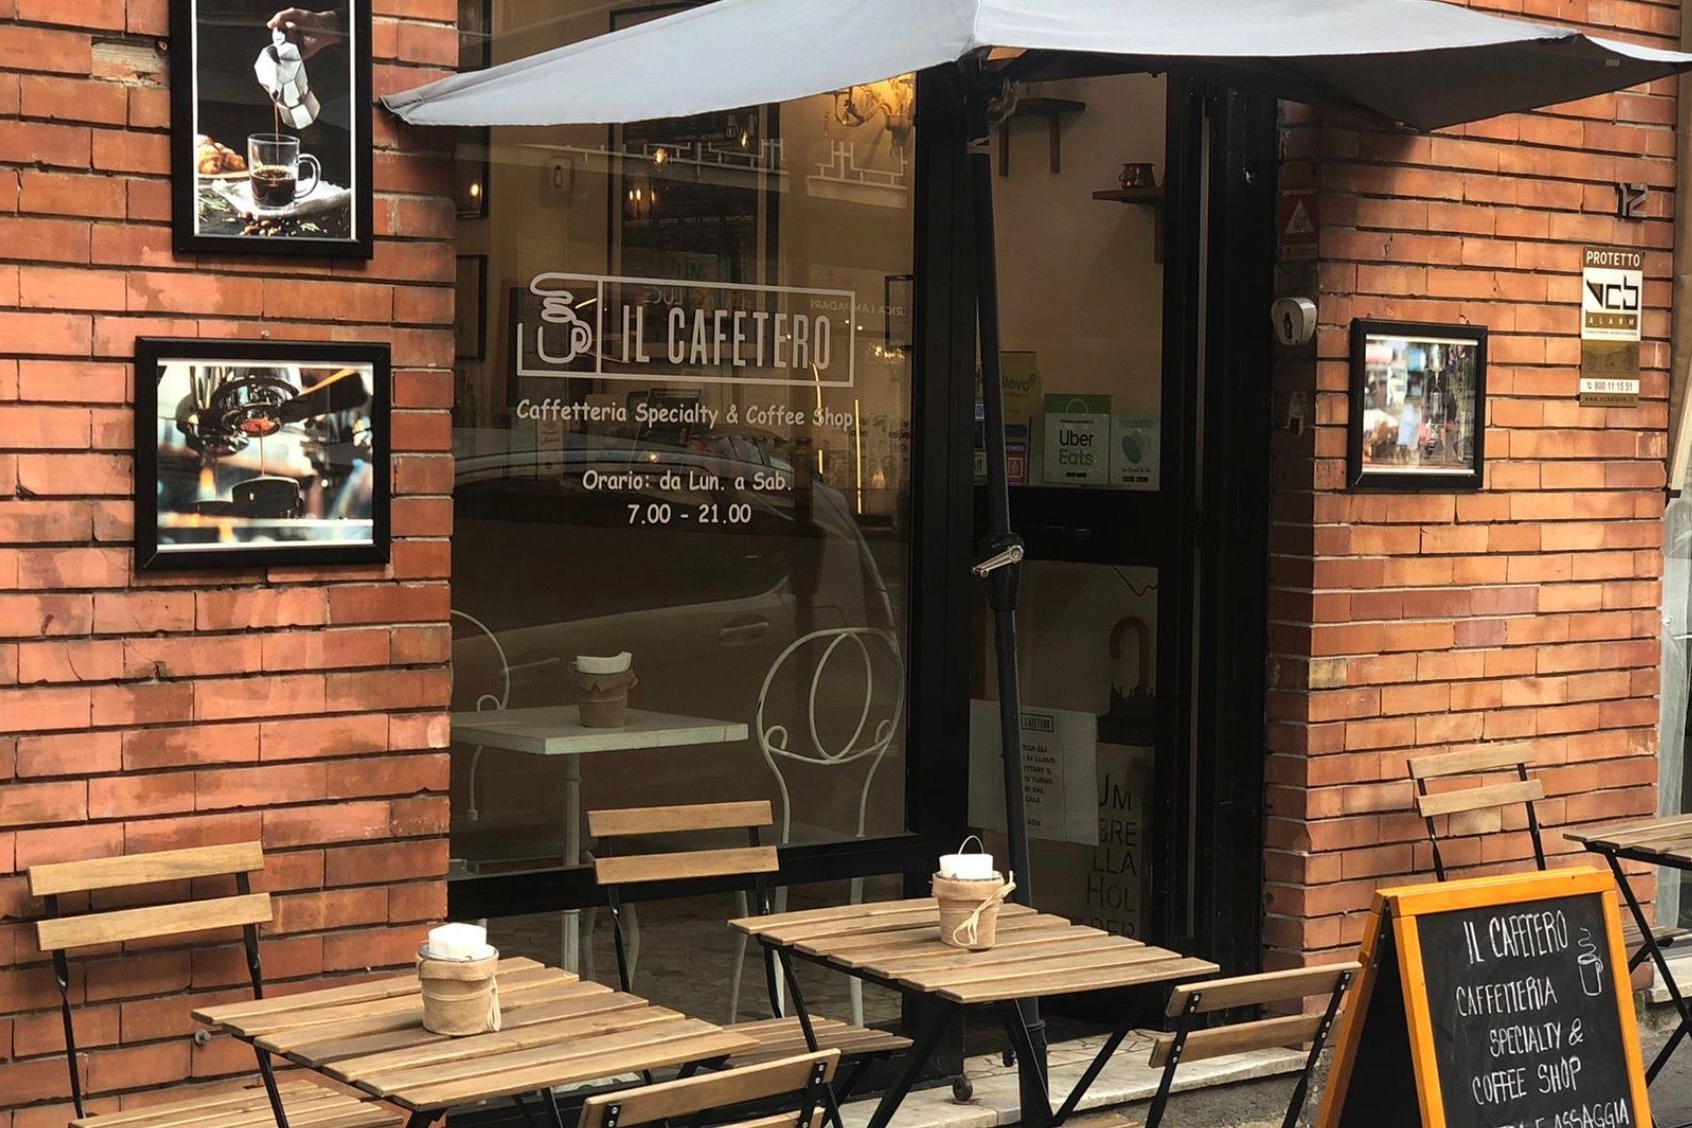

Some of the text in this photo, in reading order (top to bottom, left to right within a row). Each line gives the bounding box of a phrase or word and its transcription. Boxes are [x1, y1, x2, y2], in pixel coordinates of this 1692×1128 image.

[1617, 183, 1649, 218] 12
[1585, 250, 1641, 268] PROTETTO
[622, 304, 831, 369] IL CAFETERO
[1588, 316, 1635, 326] ALARM
[1002, 374, 1036, 392] lovo
[516, 398, 854, 431] Caffetteria Specialty & Coffee Shop
[1059, 430, 1094, 446] Uber
[1059, 450, 1094, 466] Eats
[582, 470, 792, 491] Orario: da Lun. a Sab.
[627, 504, 671, 524] 7.00
[698, 504, 752, 524] 21.00
[1087, 875, 1135, 912] HOL
[1463, 910, 1569, 964] IL CAFETERO
[1456, 976, 1558, 1017] CAFFETTERIA
[1490, 1018, 1584, 1058] SPECIALTY &
[1472, 1055, 1582, 1106] COFFEE SHOP
